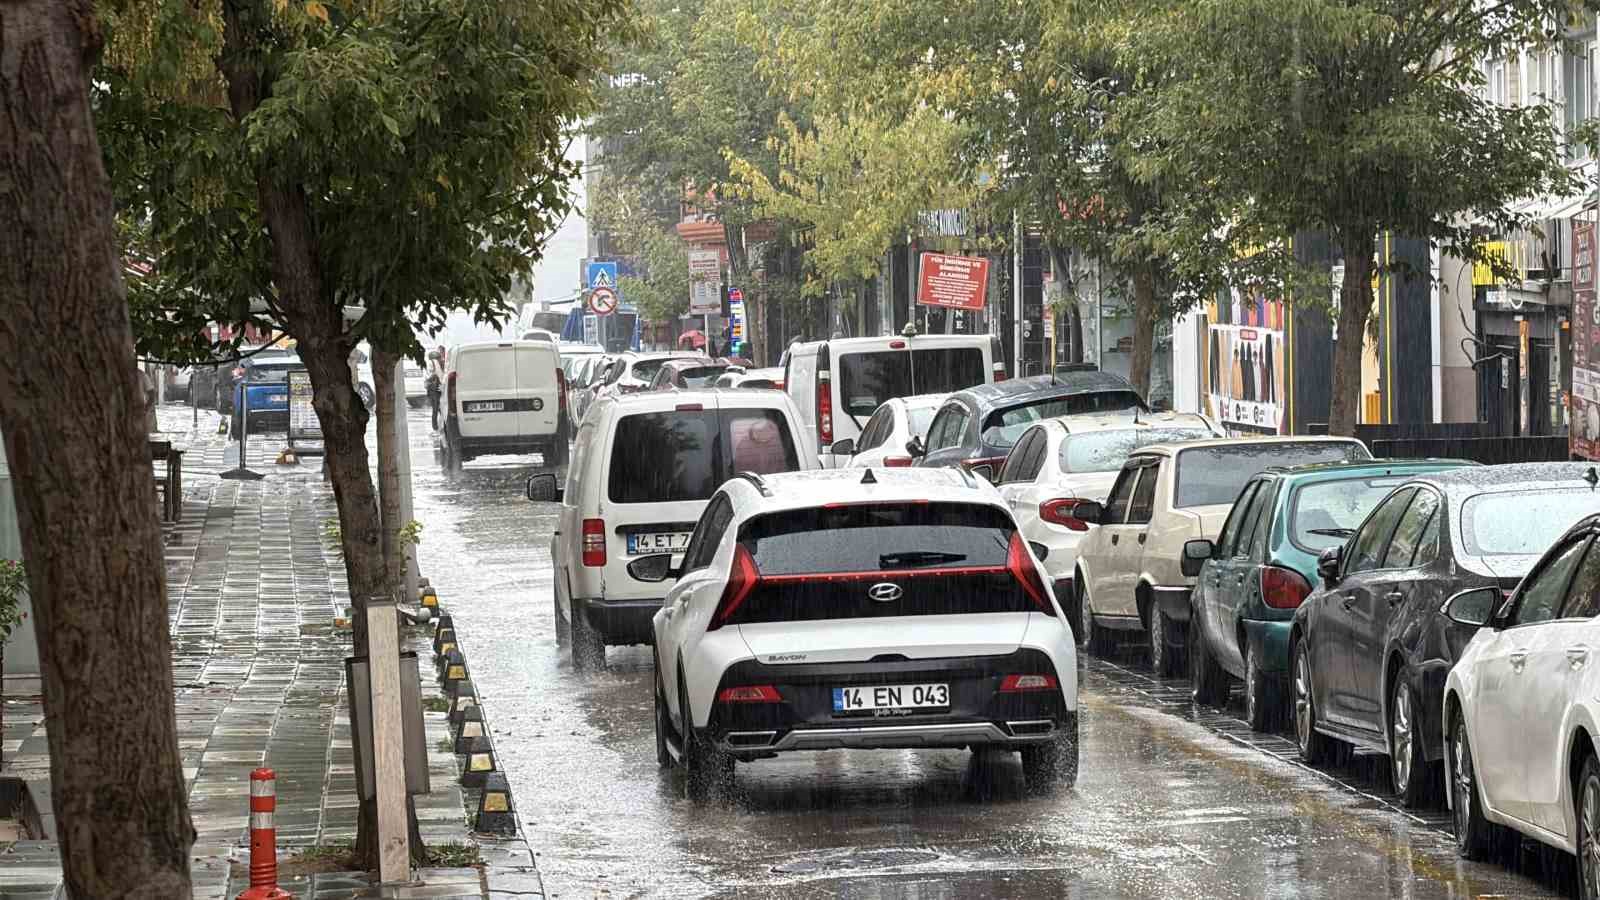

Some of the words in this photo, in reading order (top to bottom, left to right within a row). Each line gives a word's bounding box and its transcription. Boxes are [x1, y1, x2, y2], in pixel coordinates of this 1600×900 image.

[637, 535, 649, 548] 14
[655, 534, 675, 547] ET
[844, 689, 863, 708] 14
[873, 687, 902, 706] EN
[912, 686, 948, 705] 043
